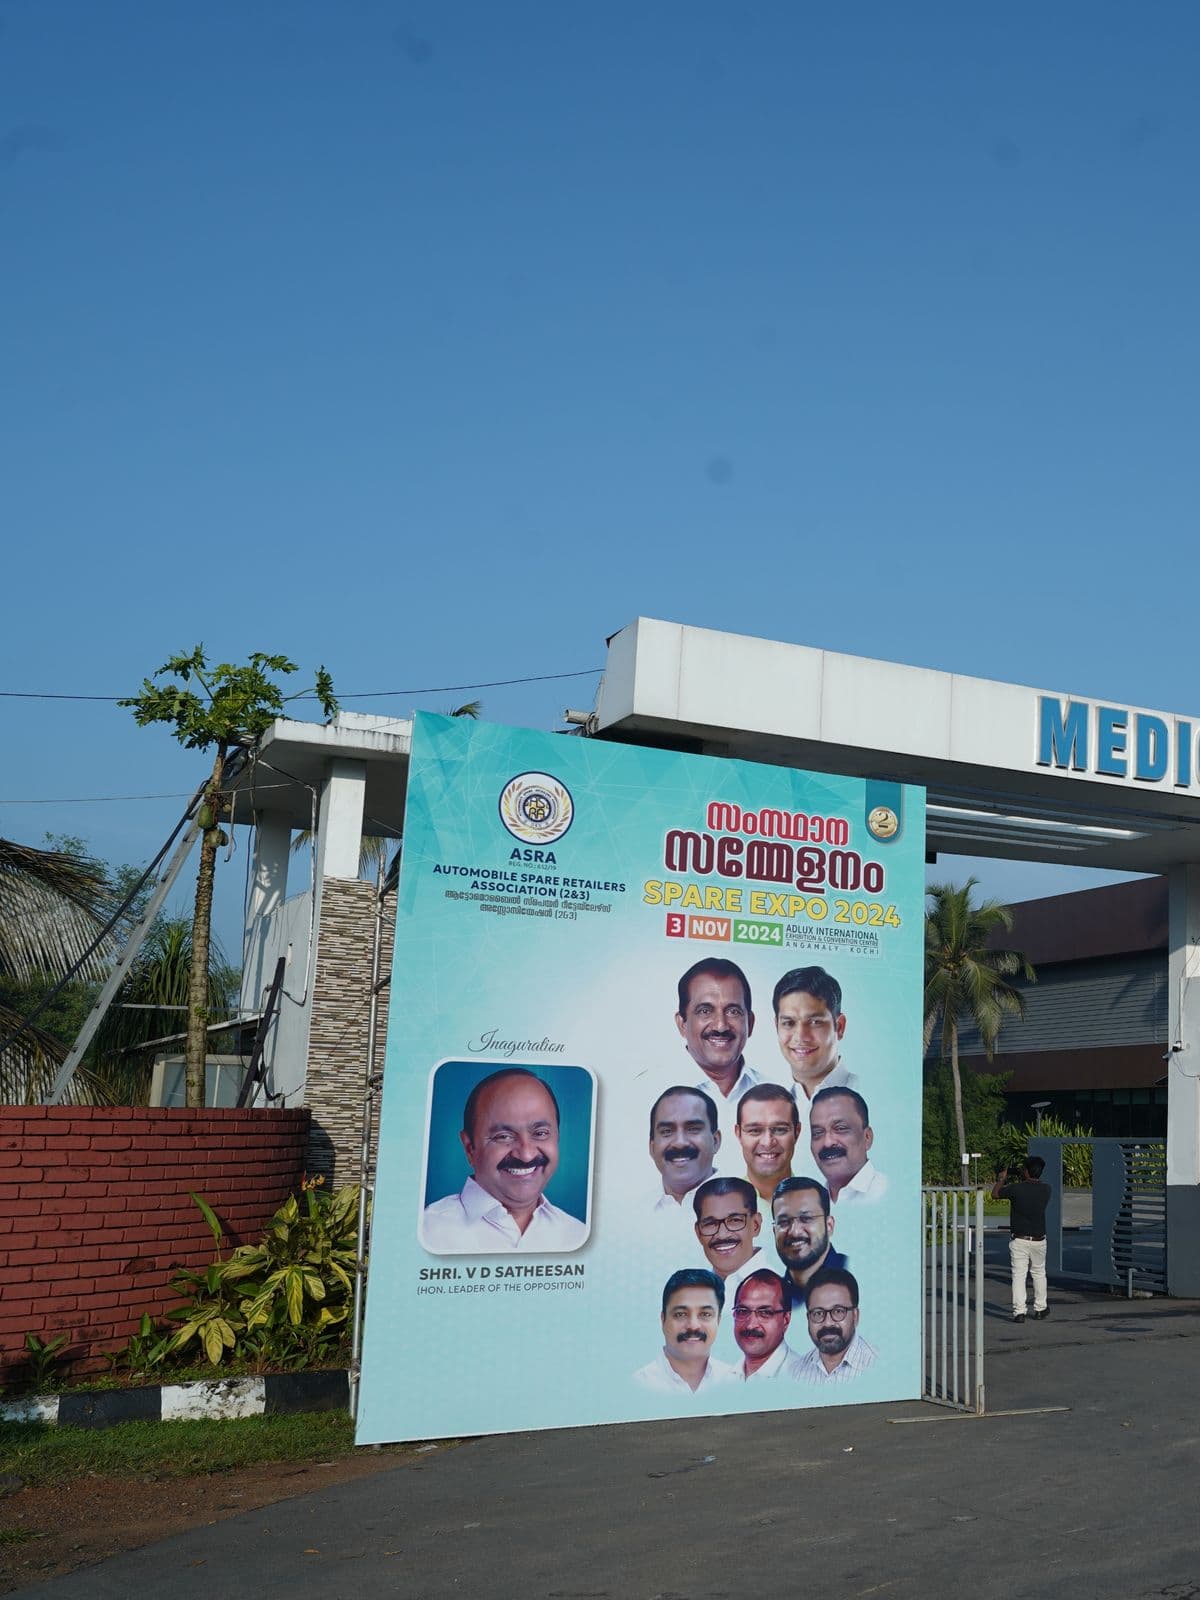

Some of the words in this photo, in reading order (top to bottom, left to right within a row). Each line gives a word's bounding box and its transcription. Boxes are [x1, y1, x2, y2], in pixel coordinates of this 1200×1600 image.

[707, 801, 849, 846] സംസ്ഥാന
[510, 848, 557, 864] ASRA
[664, 829, 885, 894] സമ്മേളനം
[433, 864, 518, 882] AUTOMOBILE
[520, 873, 560, 886] SPARE
[563, 877, 626, 892] RETAILERS
[470, 880, 557, 898] ASSOCIATION
[559, 889, 591, 901] (2&3)
[643, 880, 743, 912] SPARE
[750, 891, 828, 920] EXPO
[834, 900, 901, 928] 2024
[670, 917, 682, 933] 3
[692, 919, 728, 937] NOV
[737, 923, 782, 943] 2024
[786, 924, 814, 934] ADLUX
[816, 927, 879, 940] INTERNATIONAL
[823, 936, 858, 945] CONVENTION
[468, 1028, 566, 1057] Inaguration
[419, 1268, 461, 1280] SHRI.
[466, 1267, 477, 1279] V
[481, 1267, 491, 1278] D
[495, 1264, 585, 1278] SATHEESAN
[417, 1286, 446, 1296] (HON.
[449, 1285, 485, 1294] LEADER
[490, 1284, 501, 1292] OF
[504, 1283, 521, 1292] THE
[524, 1281, 585, 1291] OPPOSITION)
